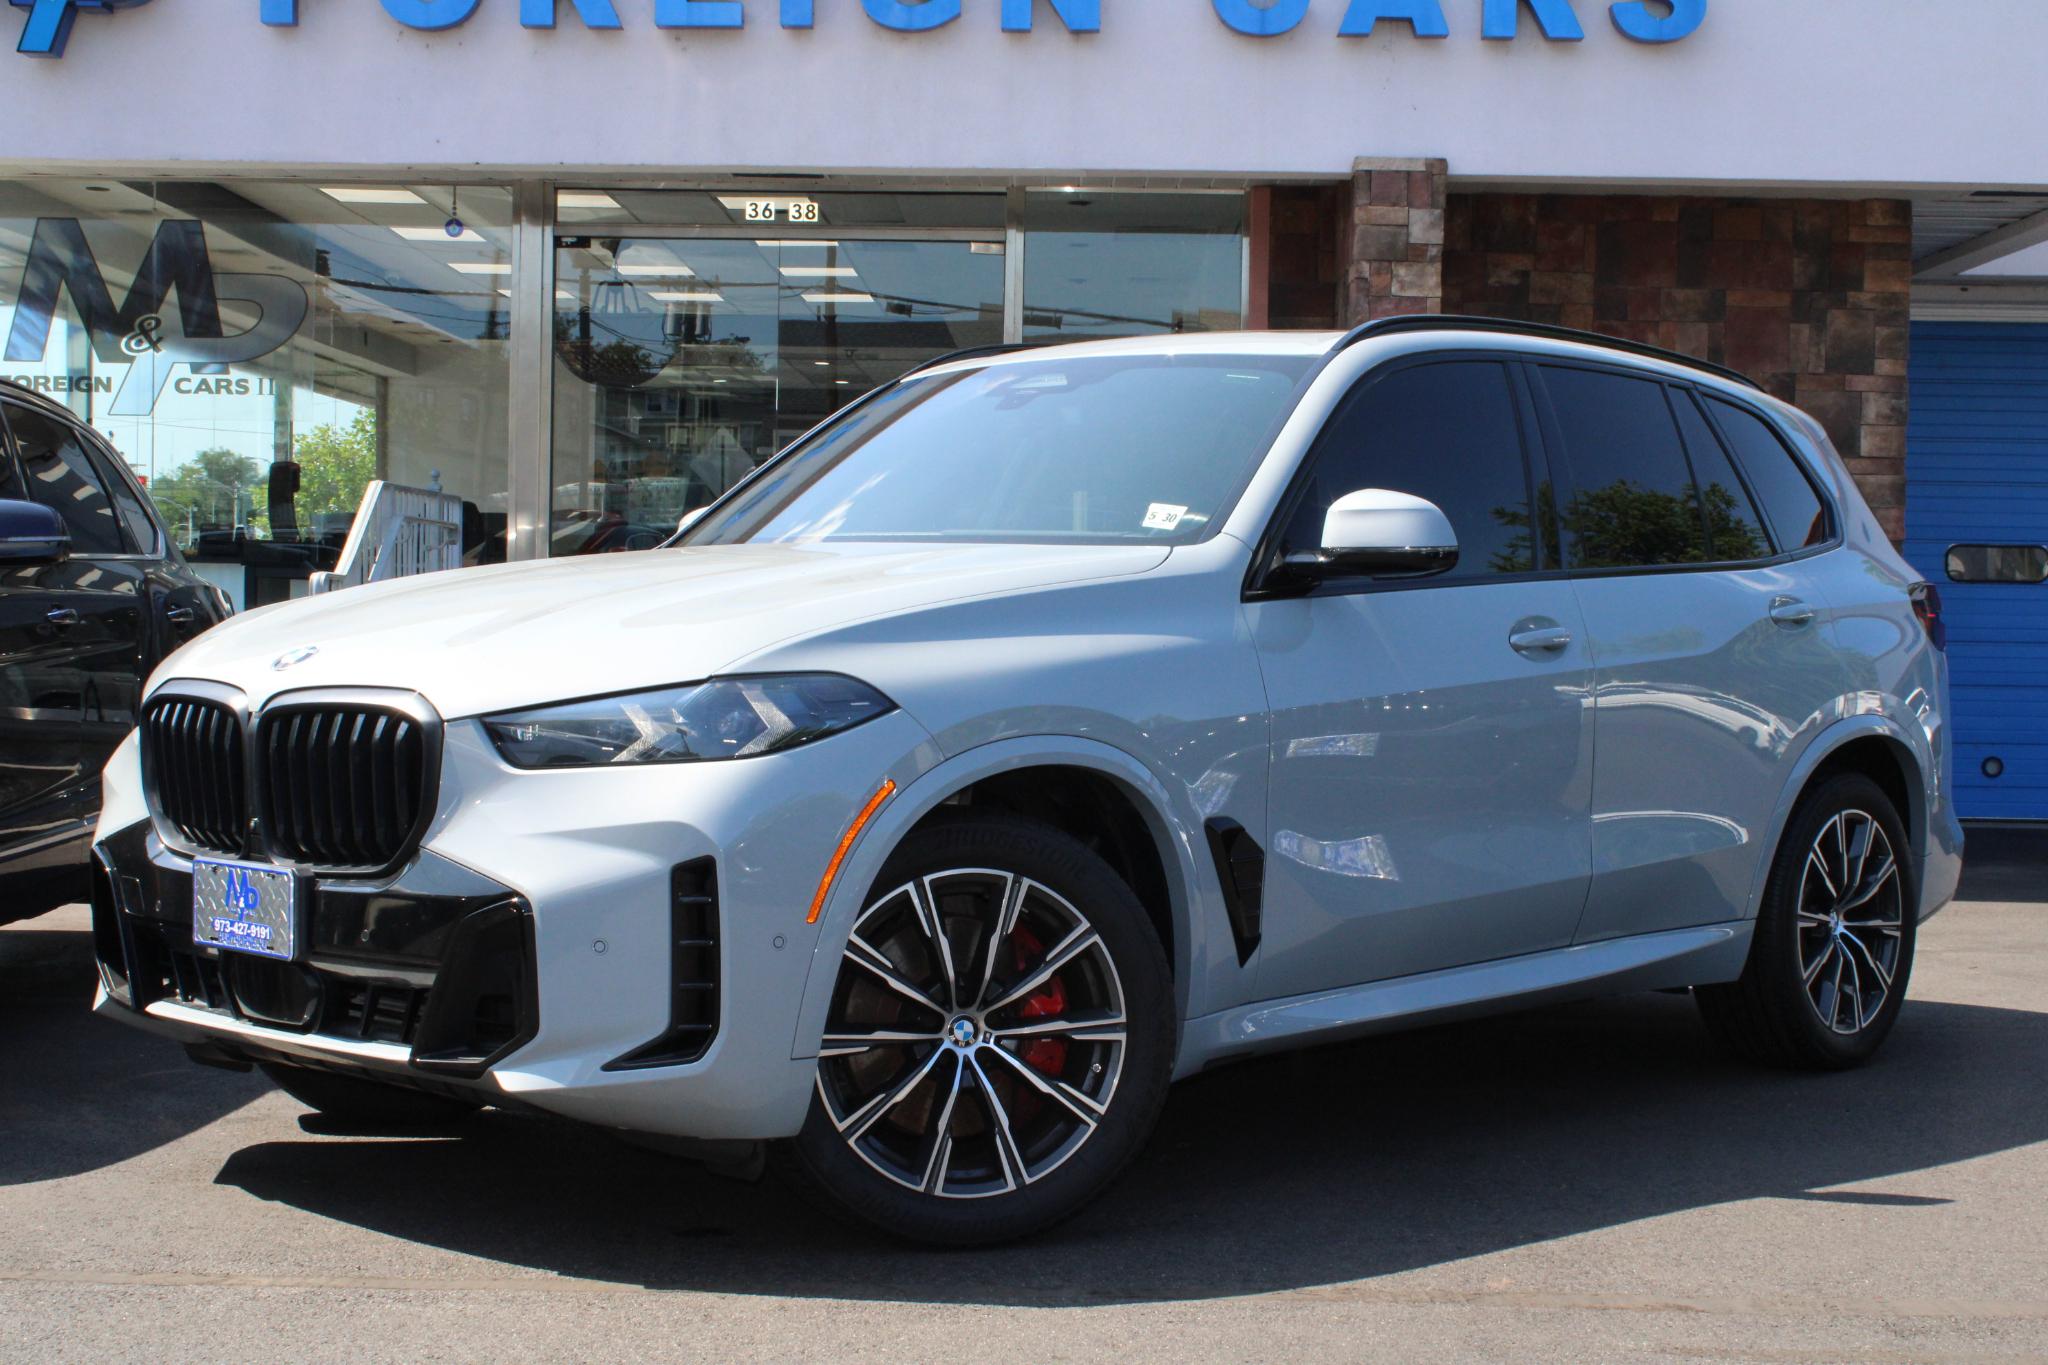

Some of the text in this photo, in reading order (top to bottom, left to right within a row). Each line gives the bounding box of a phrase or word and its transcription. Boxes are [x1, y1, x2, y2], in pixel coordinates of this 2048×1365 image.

[748, 202, 816, 220] 36-38
[174, 377, 250, 395] CARS
[257, 377, 275, 396] II
[213, 918, 270, 940] 973-427-9191
